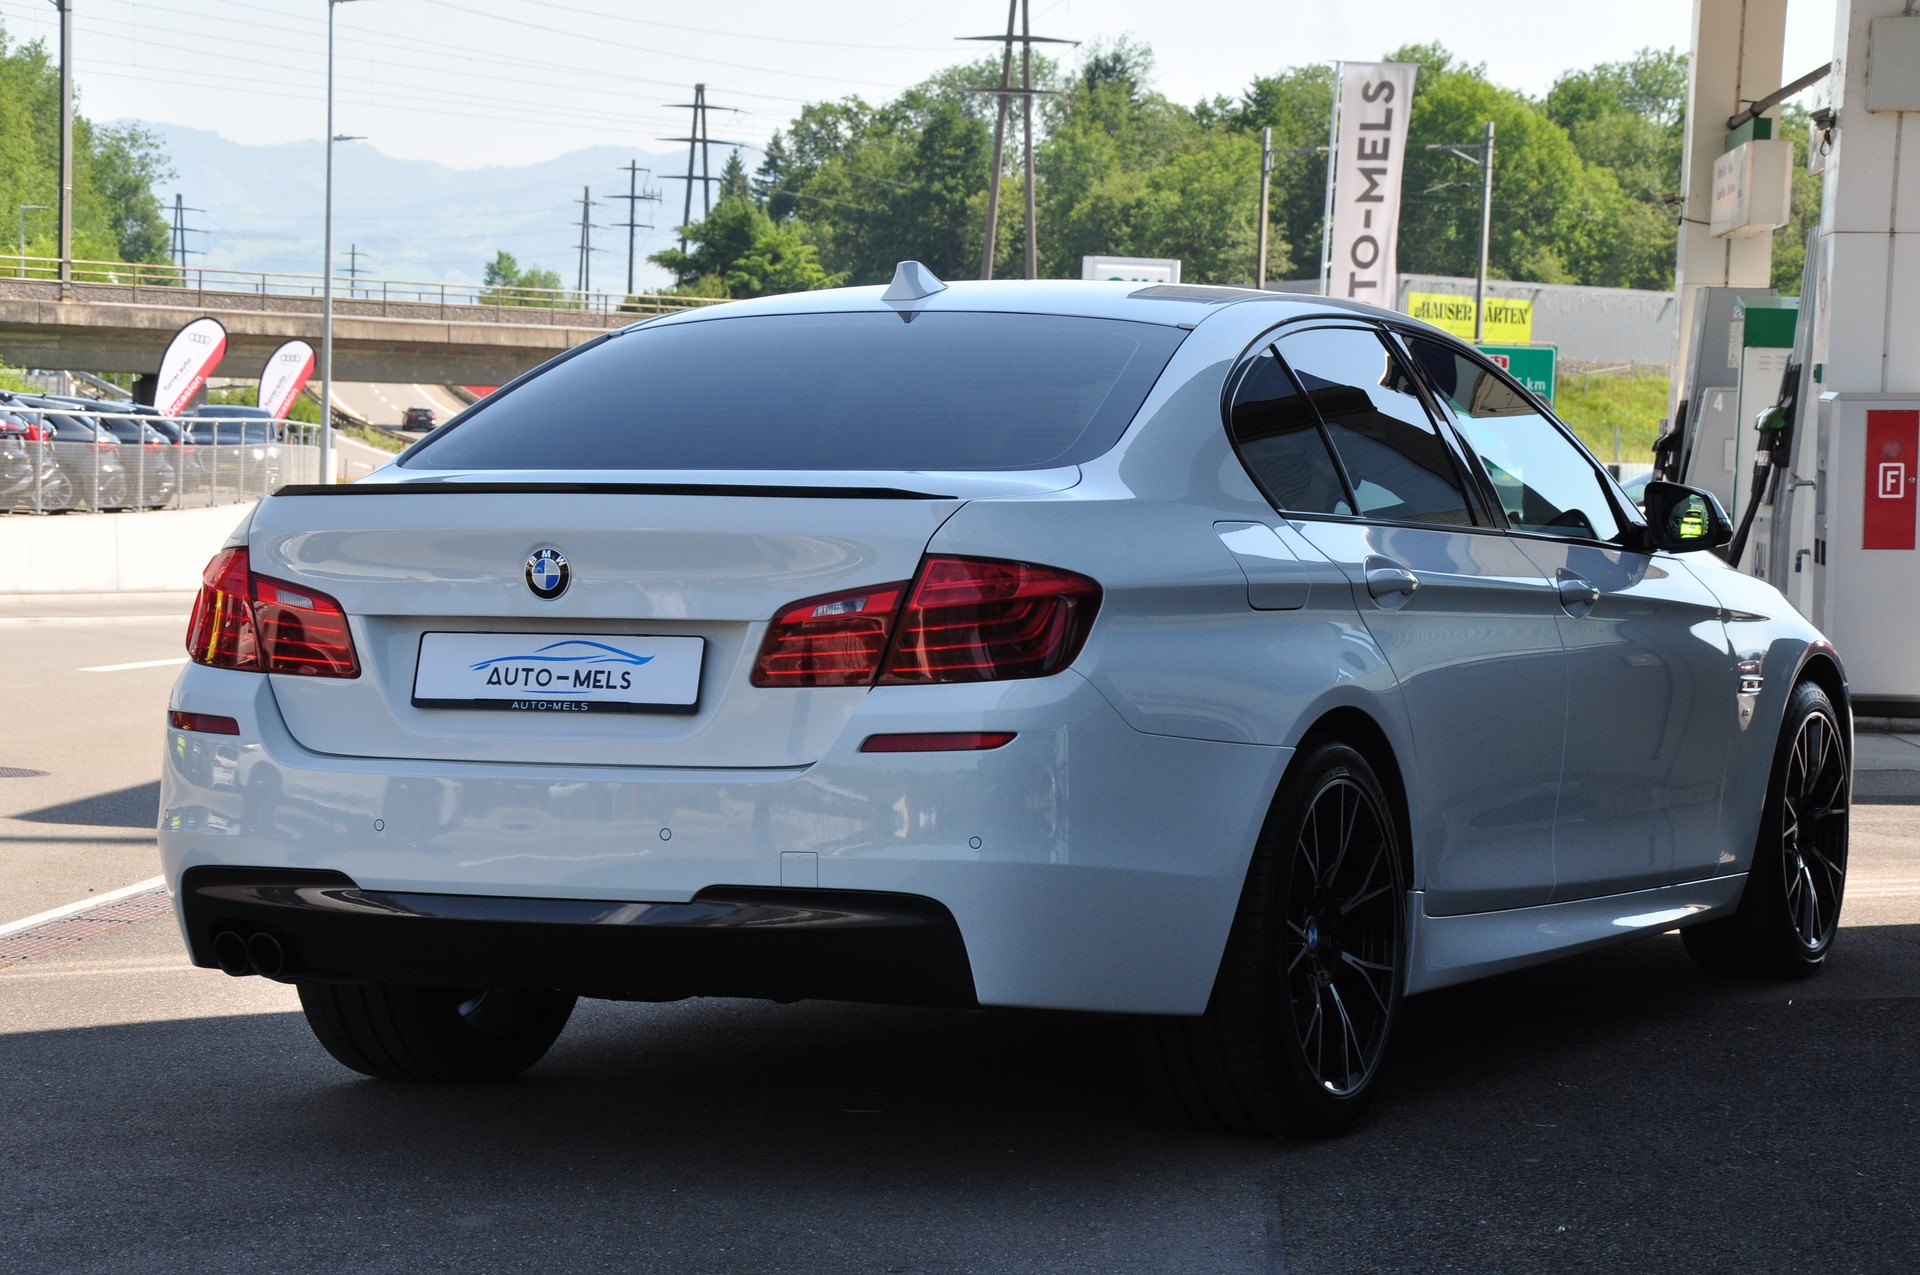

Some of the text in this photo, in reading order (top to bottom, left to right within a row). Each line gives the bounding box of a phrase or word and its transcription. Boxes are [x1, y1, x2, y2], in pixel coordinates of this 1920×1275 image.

[1348, 80, 1395, 297] TO-MELS
[1484, 302, 1528, 325] ÄRTEN
[1526, 377, 1547, 391] km
[166, 375, 204, 417] Occasion
[276, 387, 299, 419] casion
[1713, 393, 1724, 412] 4
[1886, 470, 1899, 492] F
[528, 549, 567, 567] BMW
[486, 666, 632, 690] AUTO-MELS
[511, 700, 589, 711] AUTO-MELS
